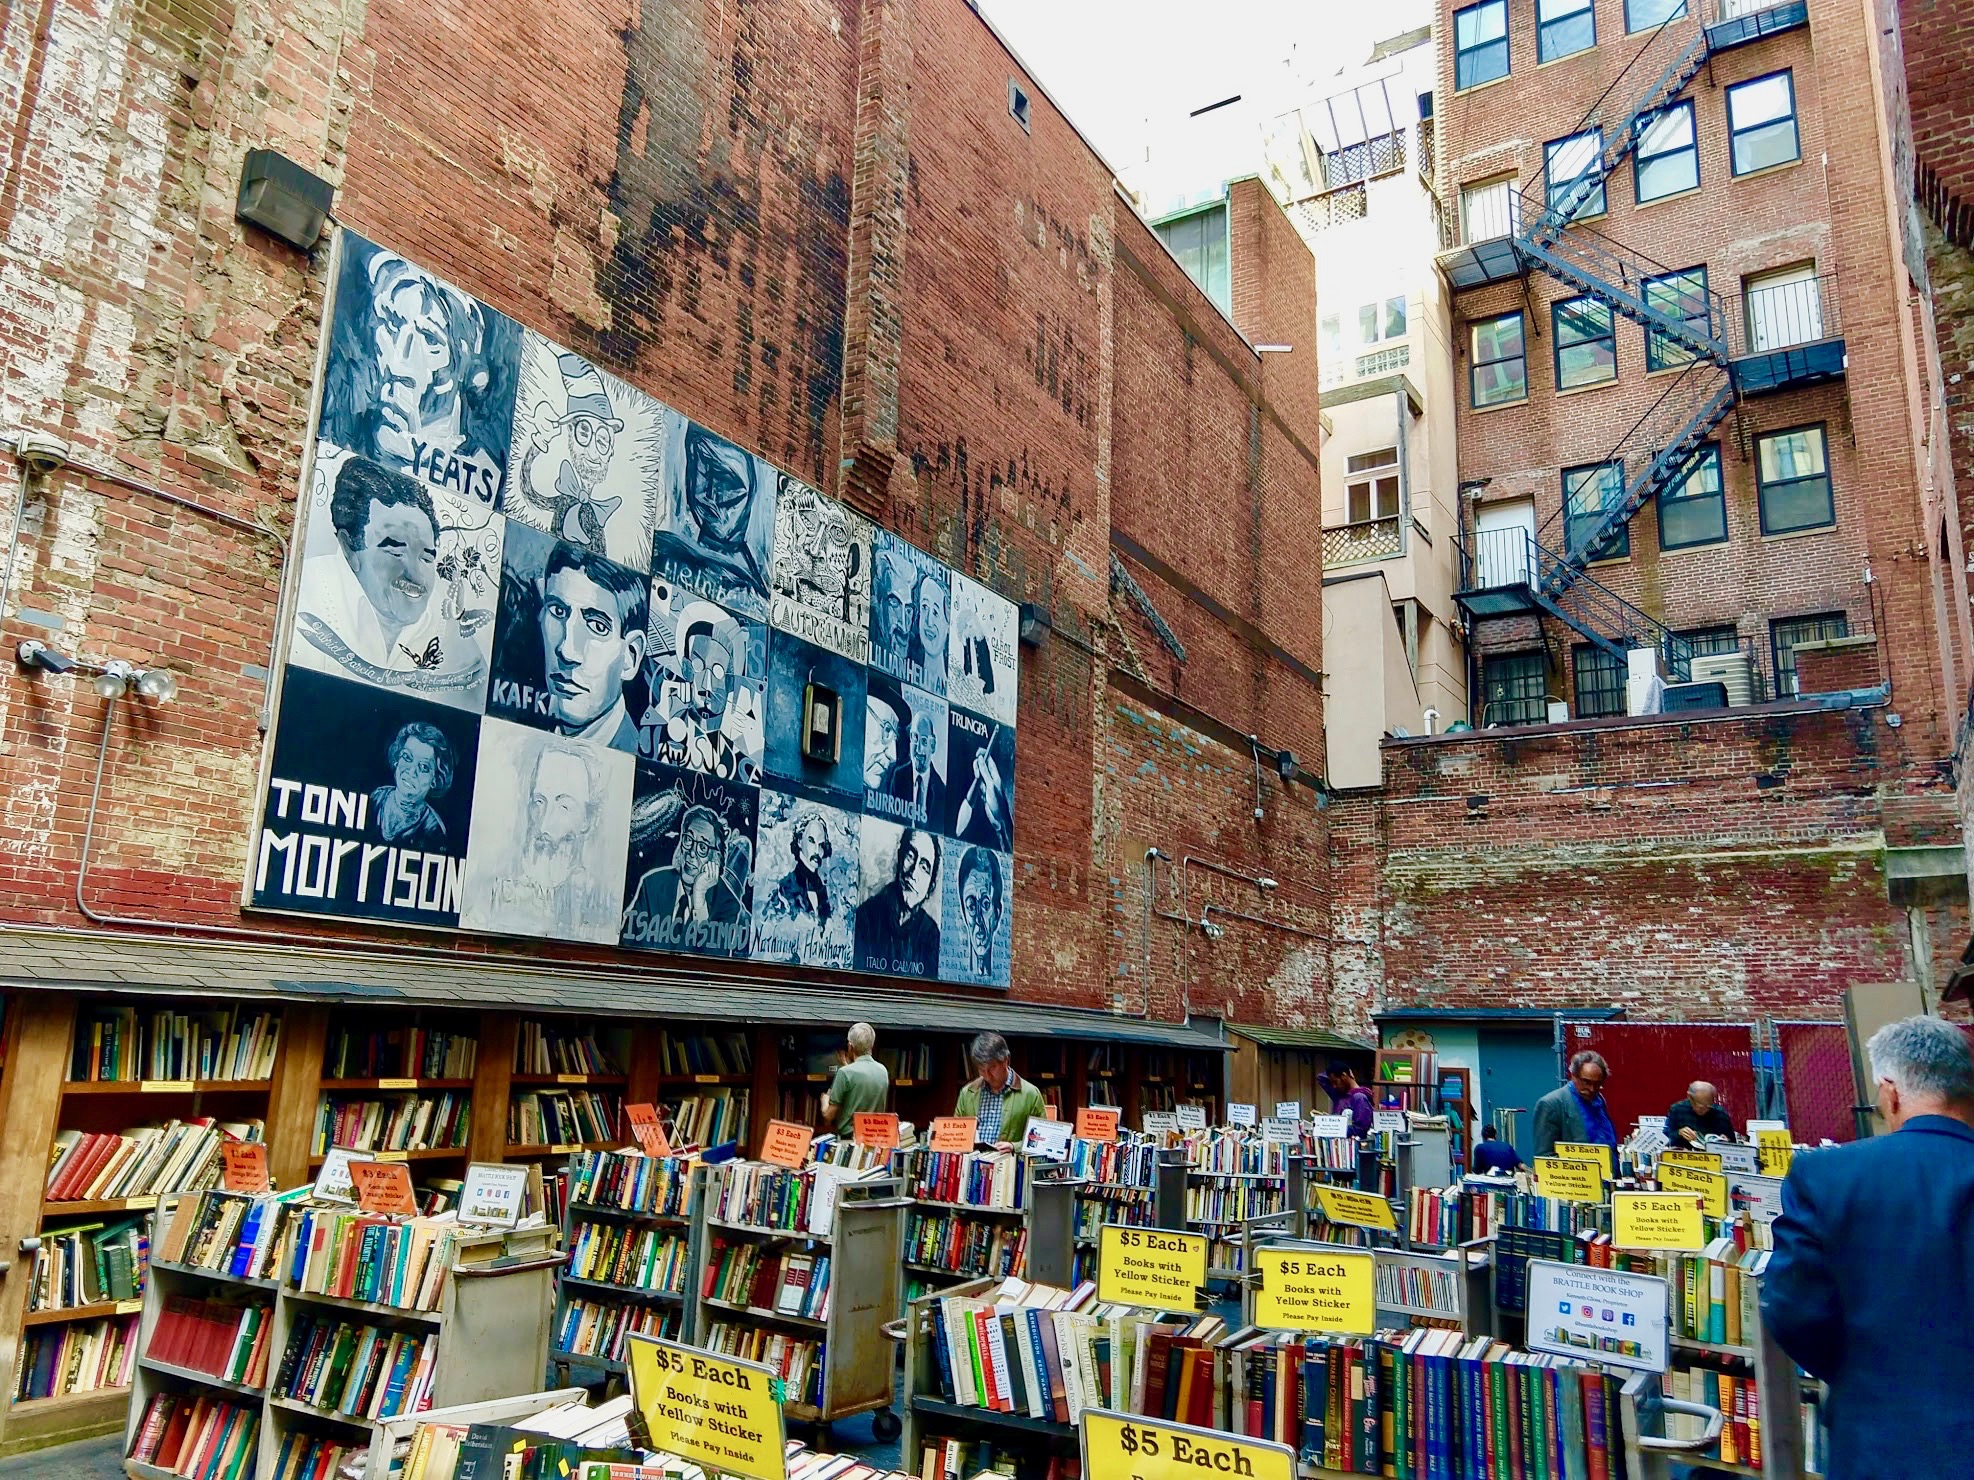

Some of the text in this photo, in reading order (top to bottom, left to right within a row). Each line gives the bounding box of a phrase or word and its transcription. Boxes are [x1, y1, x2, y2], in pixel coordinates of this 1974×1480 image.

[408, 437, 495, 503] YEATS
[303, 621, 343, 659] Gabriel
[338, 651, 376, 680] García
[868, 641, 948, 697] LILLIAN HELLMAN
[492, 678, 560, 719] KAFKA
[904, 689, 945, 716] GINSBERG
[950, 710, 989, 739] TRUNGPA
[271, 778, 369, 830] TONI
[867, 789, 928, 823] BURROUGHS
[622, 909, 751, 951] ISAAC ASIMOV
[803, 927, 852, 961] Hawthorne
[866, 957, 925, 975] ITALO CALVINO
[872, 1118, 888, 1126] Each
[953, 1122, 967, 1130] Each
[776, 1127, 802, 1140] $3 Each
[1565, 1145, 1600, 1154] $5 Each
[1671, 1153, 1710, 1162] $5 Each
[1545, 1160, 1588, 1171] $5 Each
[375, 1169, 398, 1180] Each
[1668, 1167, 1713, 1184] $5 Each
[1544, 1180, 1567, 1188] Yellow
[1671, 1181, 1710, 1195] Books with
[1345, 1195, 1372, 1206] Each
[1632, 1201, 1681, 1211] $5 Each
[1629, 1224, 1655, 1232] Yellow
[1635, 1216, 1659, 1224] Books
[253, 1229, 267, 1266] DENIALISM
[361, 1226, 376, 1263] THE ATLANTIC
[1120, 1230, 1188, 1253] $5 Each
[1123, 1256, 1182, 1273] Books with
[1280, 1260, 1347, 1277] $5 Each
[1114, 1268, 1191, 1288] Yellow Sticker
[1565, 1269, 1631, 1286] Connect with the
[1120, 1287, 1182, 1301] Please Pay Inside
[1284, 1284, 1342, 1296] Books with
[1553, 1277, 1644, 1299] BRATTLE BOOK SHOP
[1275, 1296, 1351, 1309] Yellow Sticker
[1566, 1292, 1587, 1301] Kenneth
[1602, 1298, 1628, 1308] Proprietor
[1282, 1312, 1343, 1323] Please Pay Inside
[1057, 1317, 1066, 1337] NEXT
[396, 1341, 409, 1366] THE EDGE
[1028, 1312, 1040, 1355] BENEDICTION
[1040, 1376, 1049, 1400] HARUF
[1061, 1341, 1069, 1357] KIN
[656, 1347, 752, 1391] $5 Each
[666, 1386, 749, 1420] Books with
[657, 1402, 763, 1444] Yellow Sticker
[471, 1432, 488, 1441] David
[670, 1431, 755, 1463] Please Pay Inside
[1120, 1423, 1255, 1478] $5 Each
